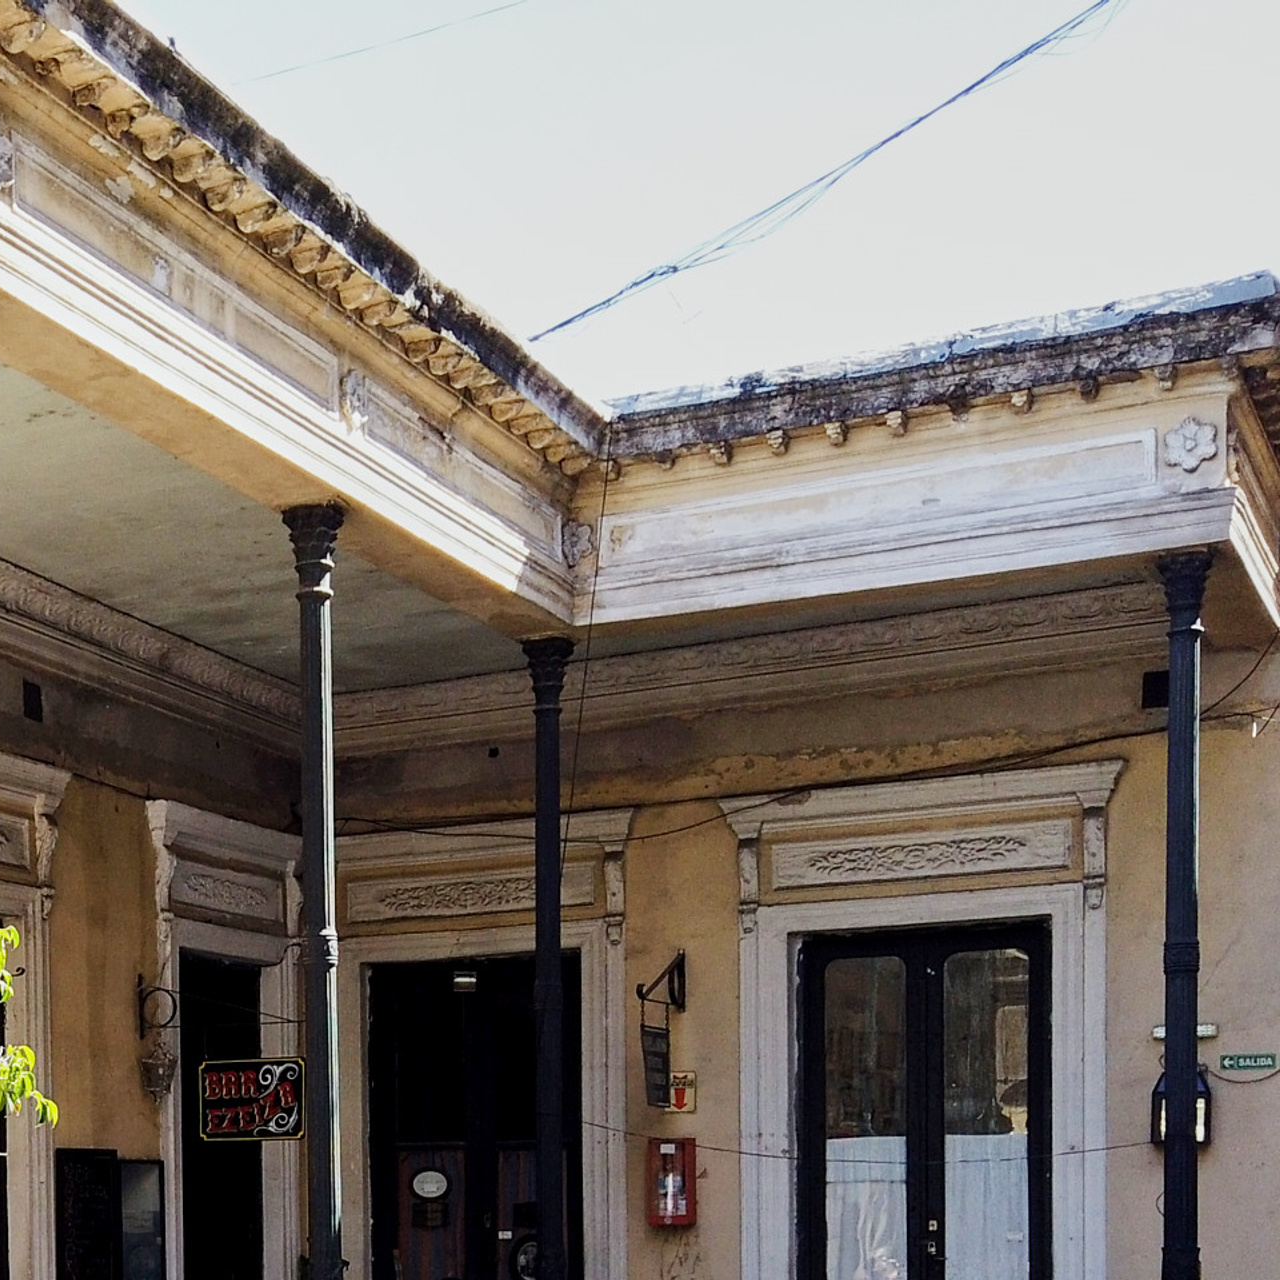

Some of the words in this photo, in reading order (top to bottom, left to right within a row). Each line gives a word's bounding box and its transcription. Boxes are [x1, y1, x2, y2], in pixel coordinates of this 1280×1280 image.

[1238, 1057, 1273, 1067] SALIDA
[204, 1070, 259, 1100] BAR
[206, 1081, 297, 1134] EZEIZA
